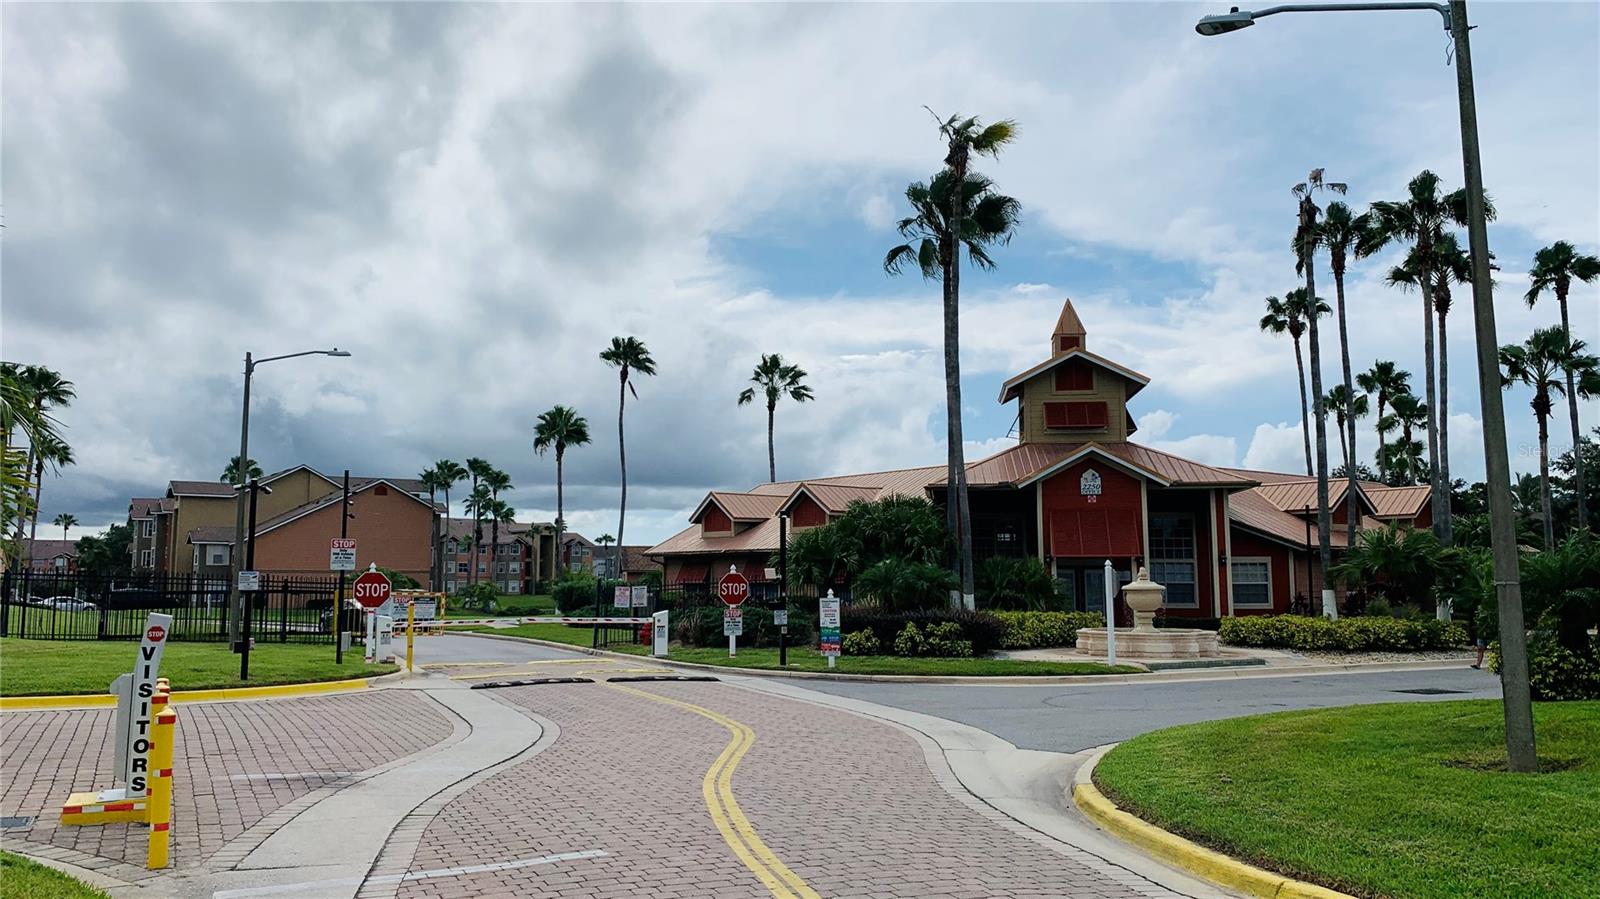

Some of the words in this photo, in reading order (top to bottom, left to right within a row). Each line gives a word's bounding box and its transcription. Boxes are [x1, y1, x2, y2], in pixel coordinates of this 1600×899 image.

[333, 540, 355, 548] STOP
[356, 583, 389, 597] STOP
[721, 583, 747, 595] STOP
[131, 647, 156, 792] VISITORS
